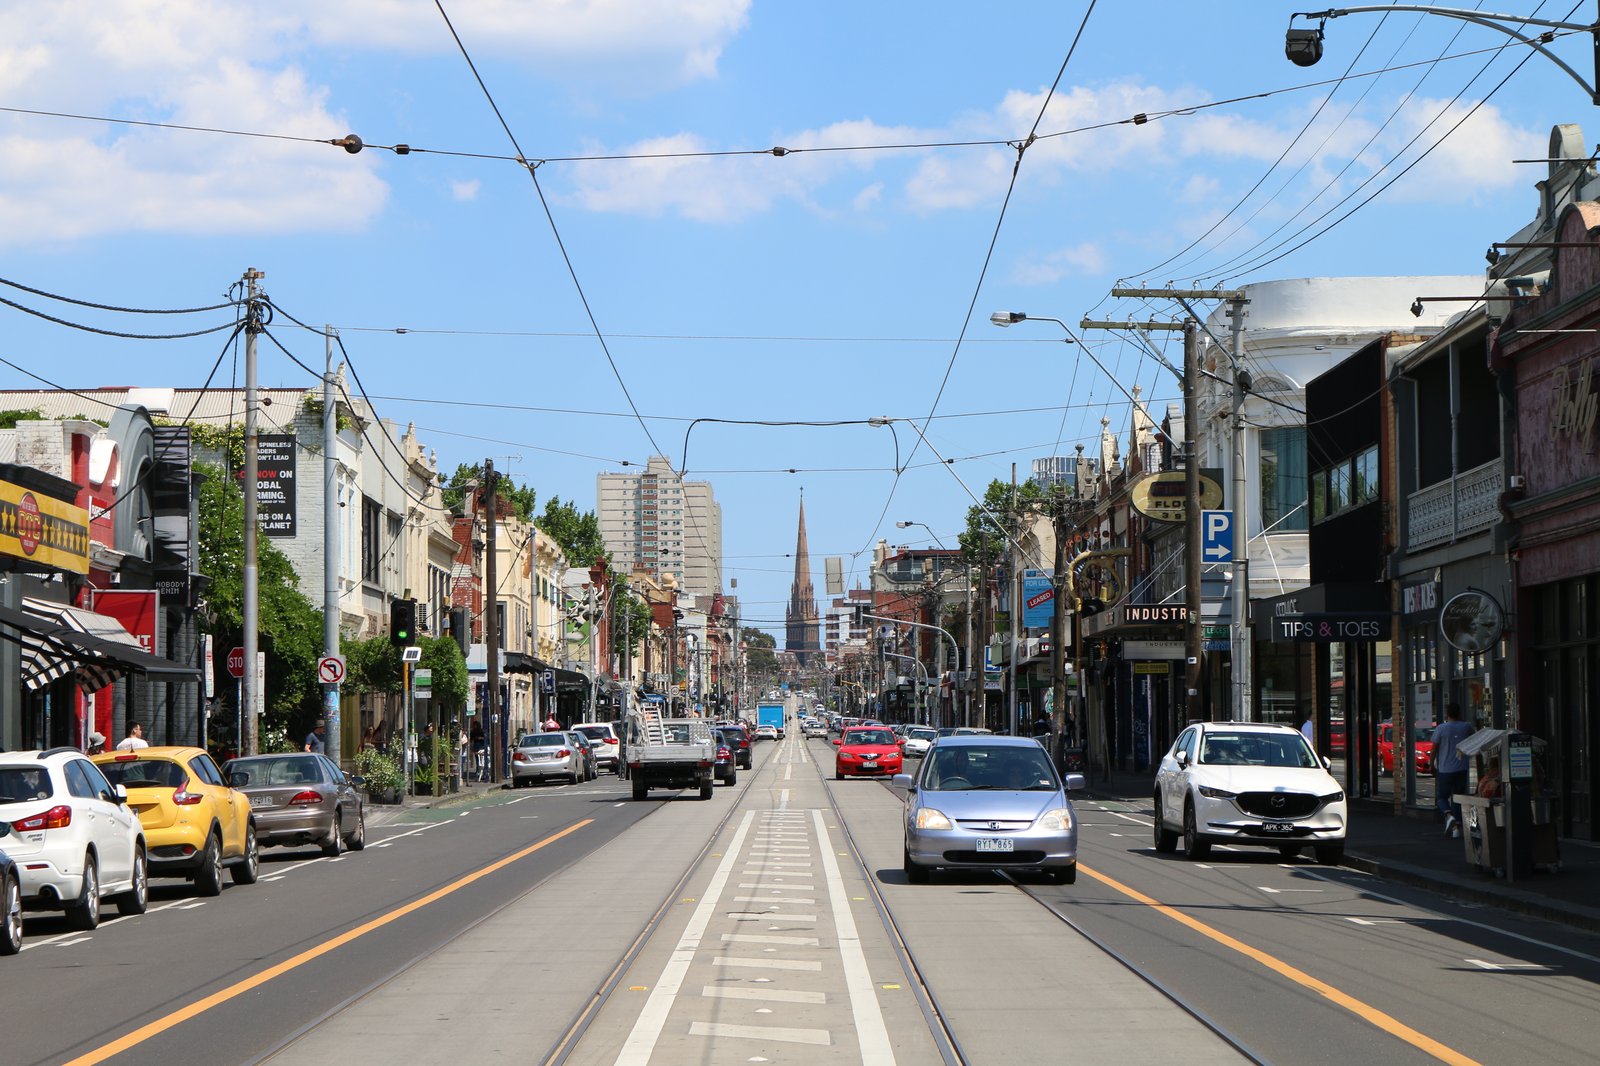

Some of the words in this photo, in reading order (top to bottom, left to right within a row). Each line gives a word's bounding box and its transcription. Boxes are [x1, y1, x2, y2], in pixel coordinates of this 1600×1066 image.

[257, 481, 281, 489] OBAL
[1208, 514, 1229, 541] P
[1029, 592, 1051, 607] LEASED
[1126, 608, 1187, 620] INDUSTR
[1281, 622, 1313, 637] TIPS
[1319, 621, 1332, 637] &
[1337, 621, 1380, 636] TOES
[229, 657, 243, 668] STO
[544, 672, 551, 684] P
[977, 839, 991, 848] RYT
[997, 839, 1012, 848] 865
